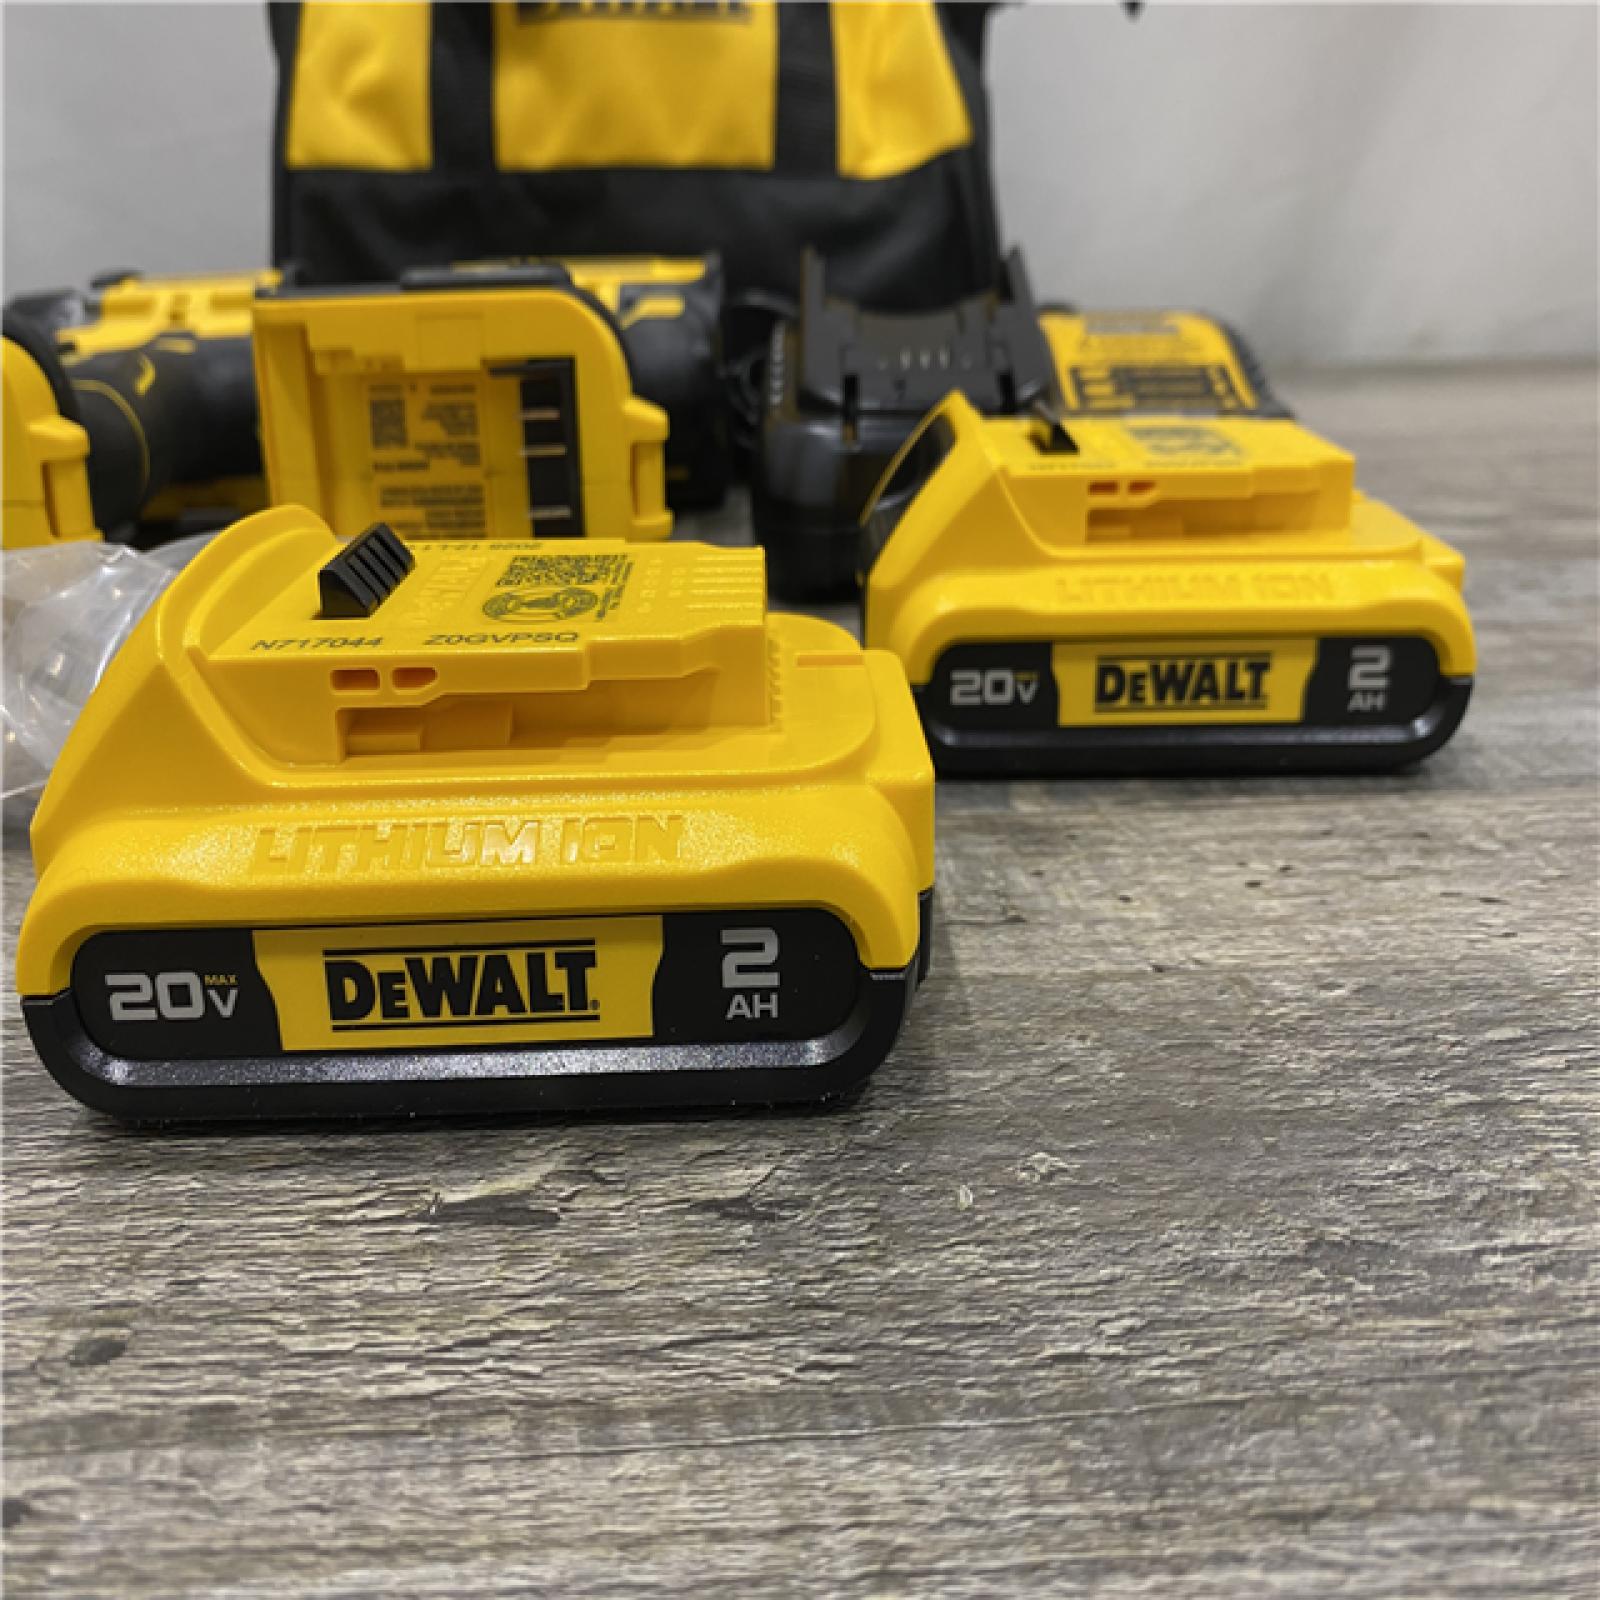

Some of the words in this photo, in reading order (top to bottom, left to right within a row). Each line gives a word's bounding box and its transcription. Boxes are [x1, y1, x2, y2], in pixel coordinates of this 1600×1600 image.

[1095, 658, 1270, 710] DEWALT
[1348, 646, 1391, 690] 2
[1348, 691, 1387, 712] AH
[251, 817, 542, 876] LITHIUM
[559, 813, 685, 866] ION
[204, 973, 239, 986] MAX
[721, 927, 779, 988] 2
[326, 950, 600, 1024] DEWALT
[726, 990, 779, 1020] AH
